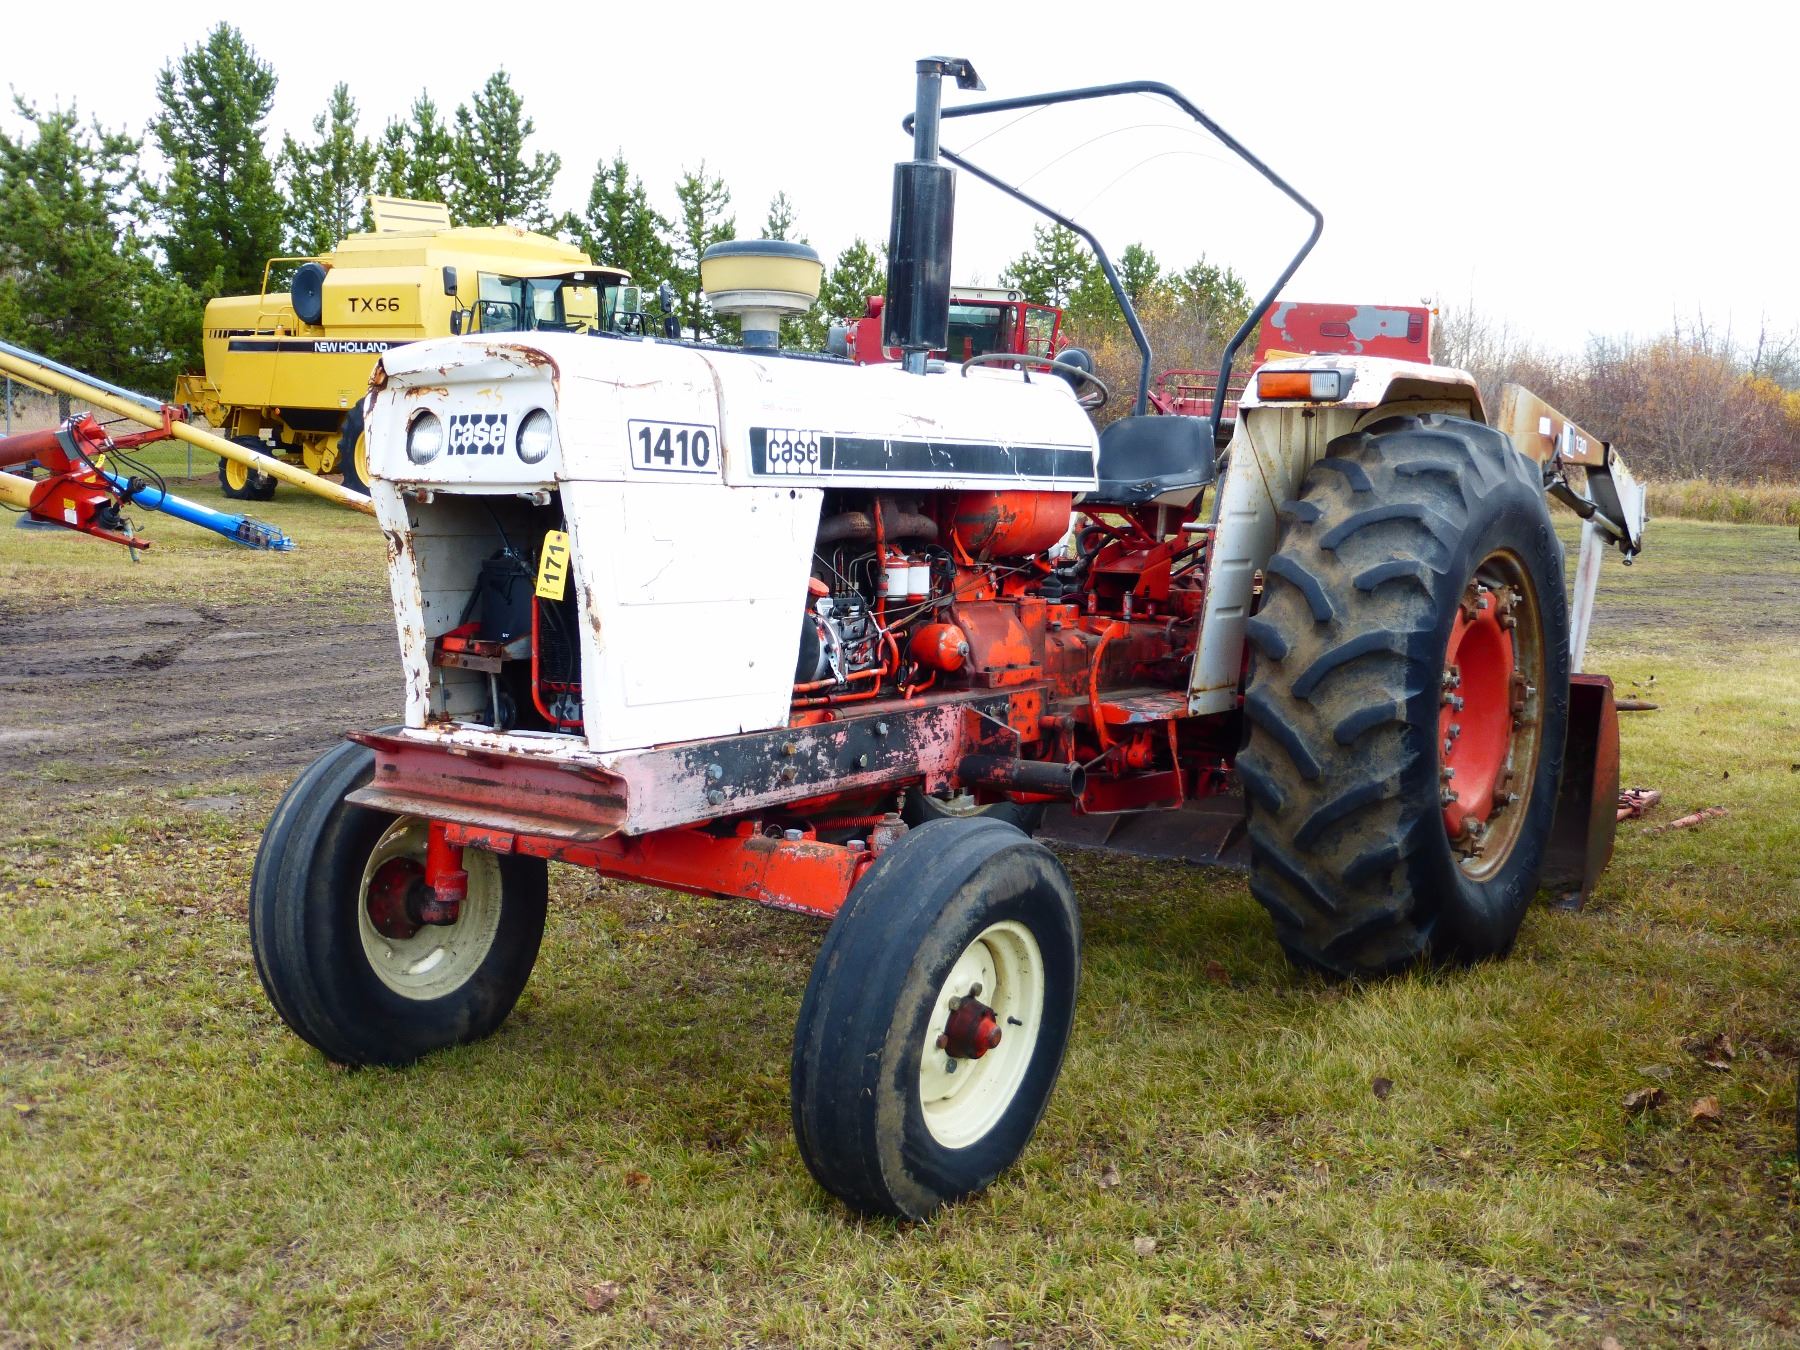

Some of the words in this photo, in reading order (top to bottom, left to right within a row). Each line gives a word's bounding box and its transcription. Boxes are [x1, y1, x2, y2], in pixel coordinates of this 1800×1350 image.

[347, 297, 400, 312] TX66
[314, 342, 337, 353] NEW
[339, 342, 388, 353] HOLLAND
[639, 427, 710, 467] 1410
[543, 544, 565, 584] 171
